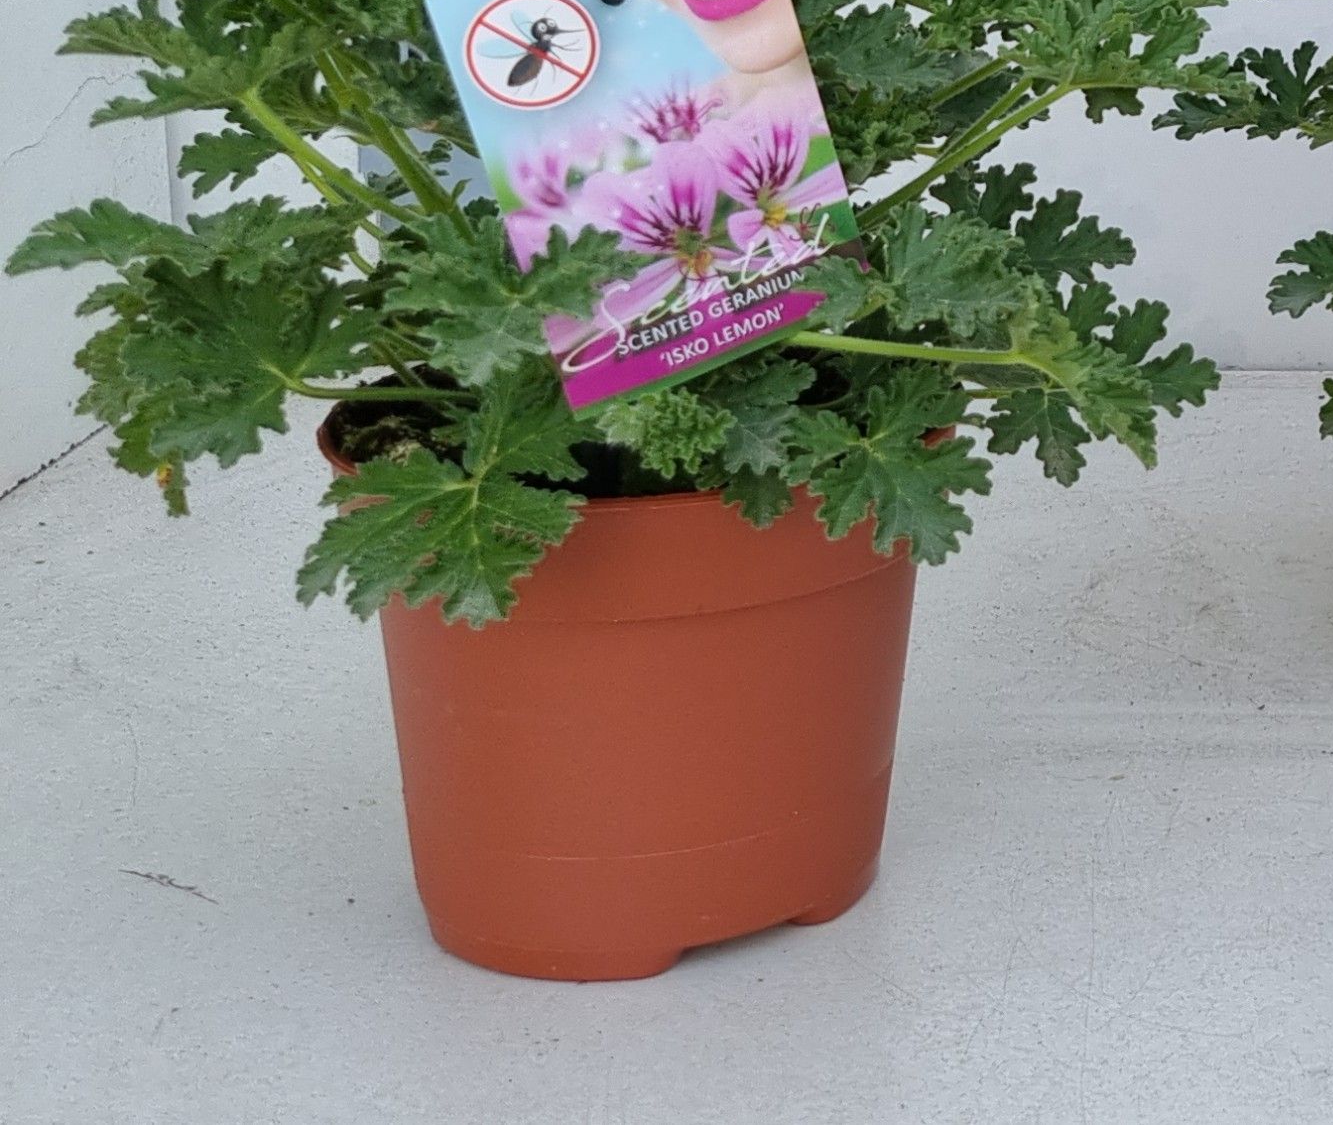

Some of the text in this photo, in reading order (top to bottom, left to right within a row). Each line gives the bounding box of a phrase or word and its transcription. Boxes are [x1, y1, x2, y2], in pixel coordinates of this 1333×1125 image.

[561, 212, 836, 372] Scented
[617, 309, 704, 355] SCENTED
[660, 303, 784, 367] 'ISKO LEMON'
